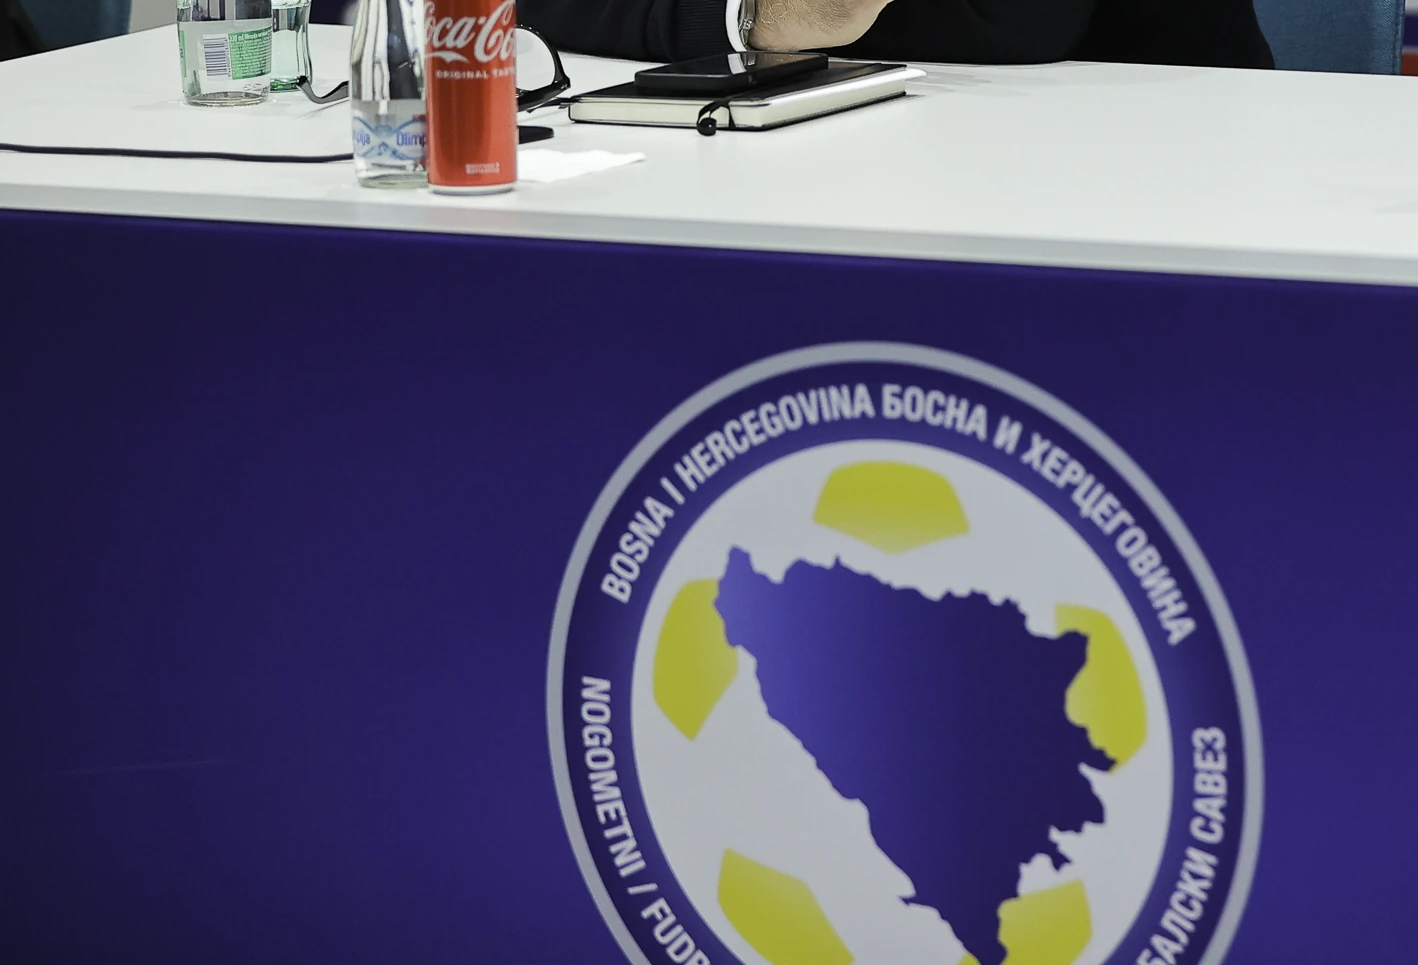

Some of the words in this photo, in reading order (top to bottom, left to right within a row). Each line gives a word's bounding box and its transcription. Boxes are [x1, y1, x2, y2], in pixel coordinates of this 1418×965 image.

[601, 495, 674, 604] BOSNA
[660, 476, 686, 505] I
[674, 383, 876, 492] HERCEGOVINA
[881, 383, 988, 442] БОСНА
[993, 415, 1023, 454] И
[1021, 432, 1197, 646] ХЕРЦЕГОВИНА
[581, 675, 647, 878] NOGOMETNI
[1189, 726, 1228, 845] САВЕЗ
